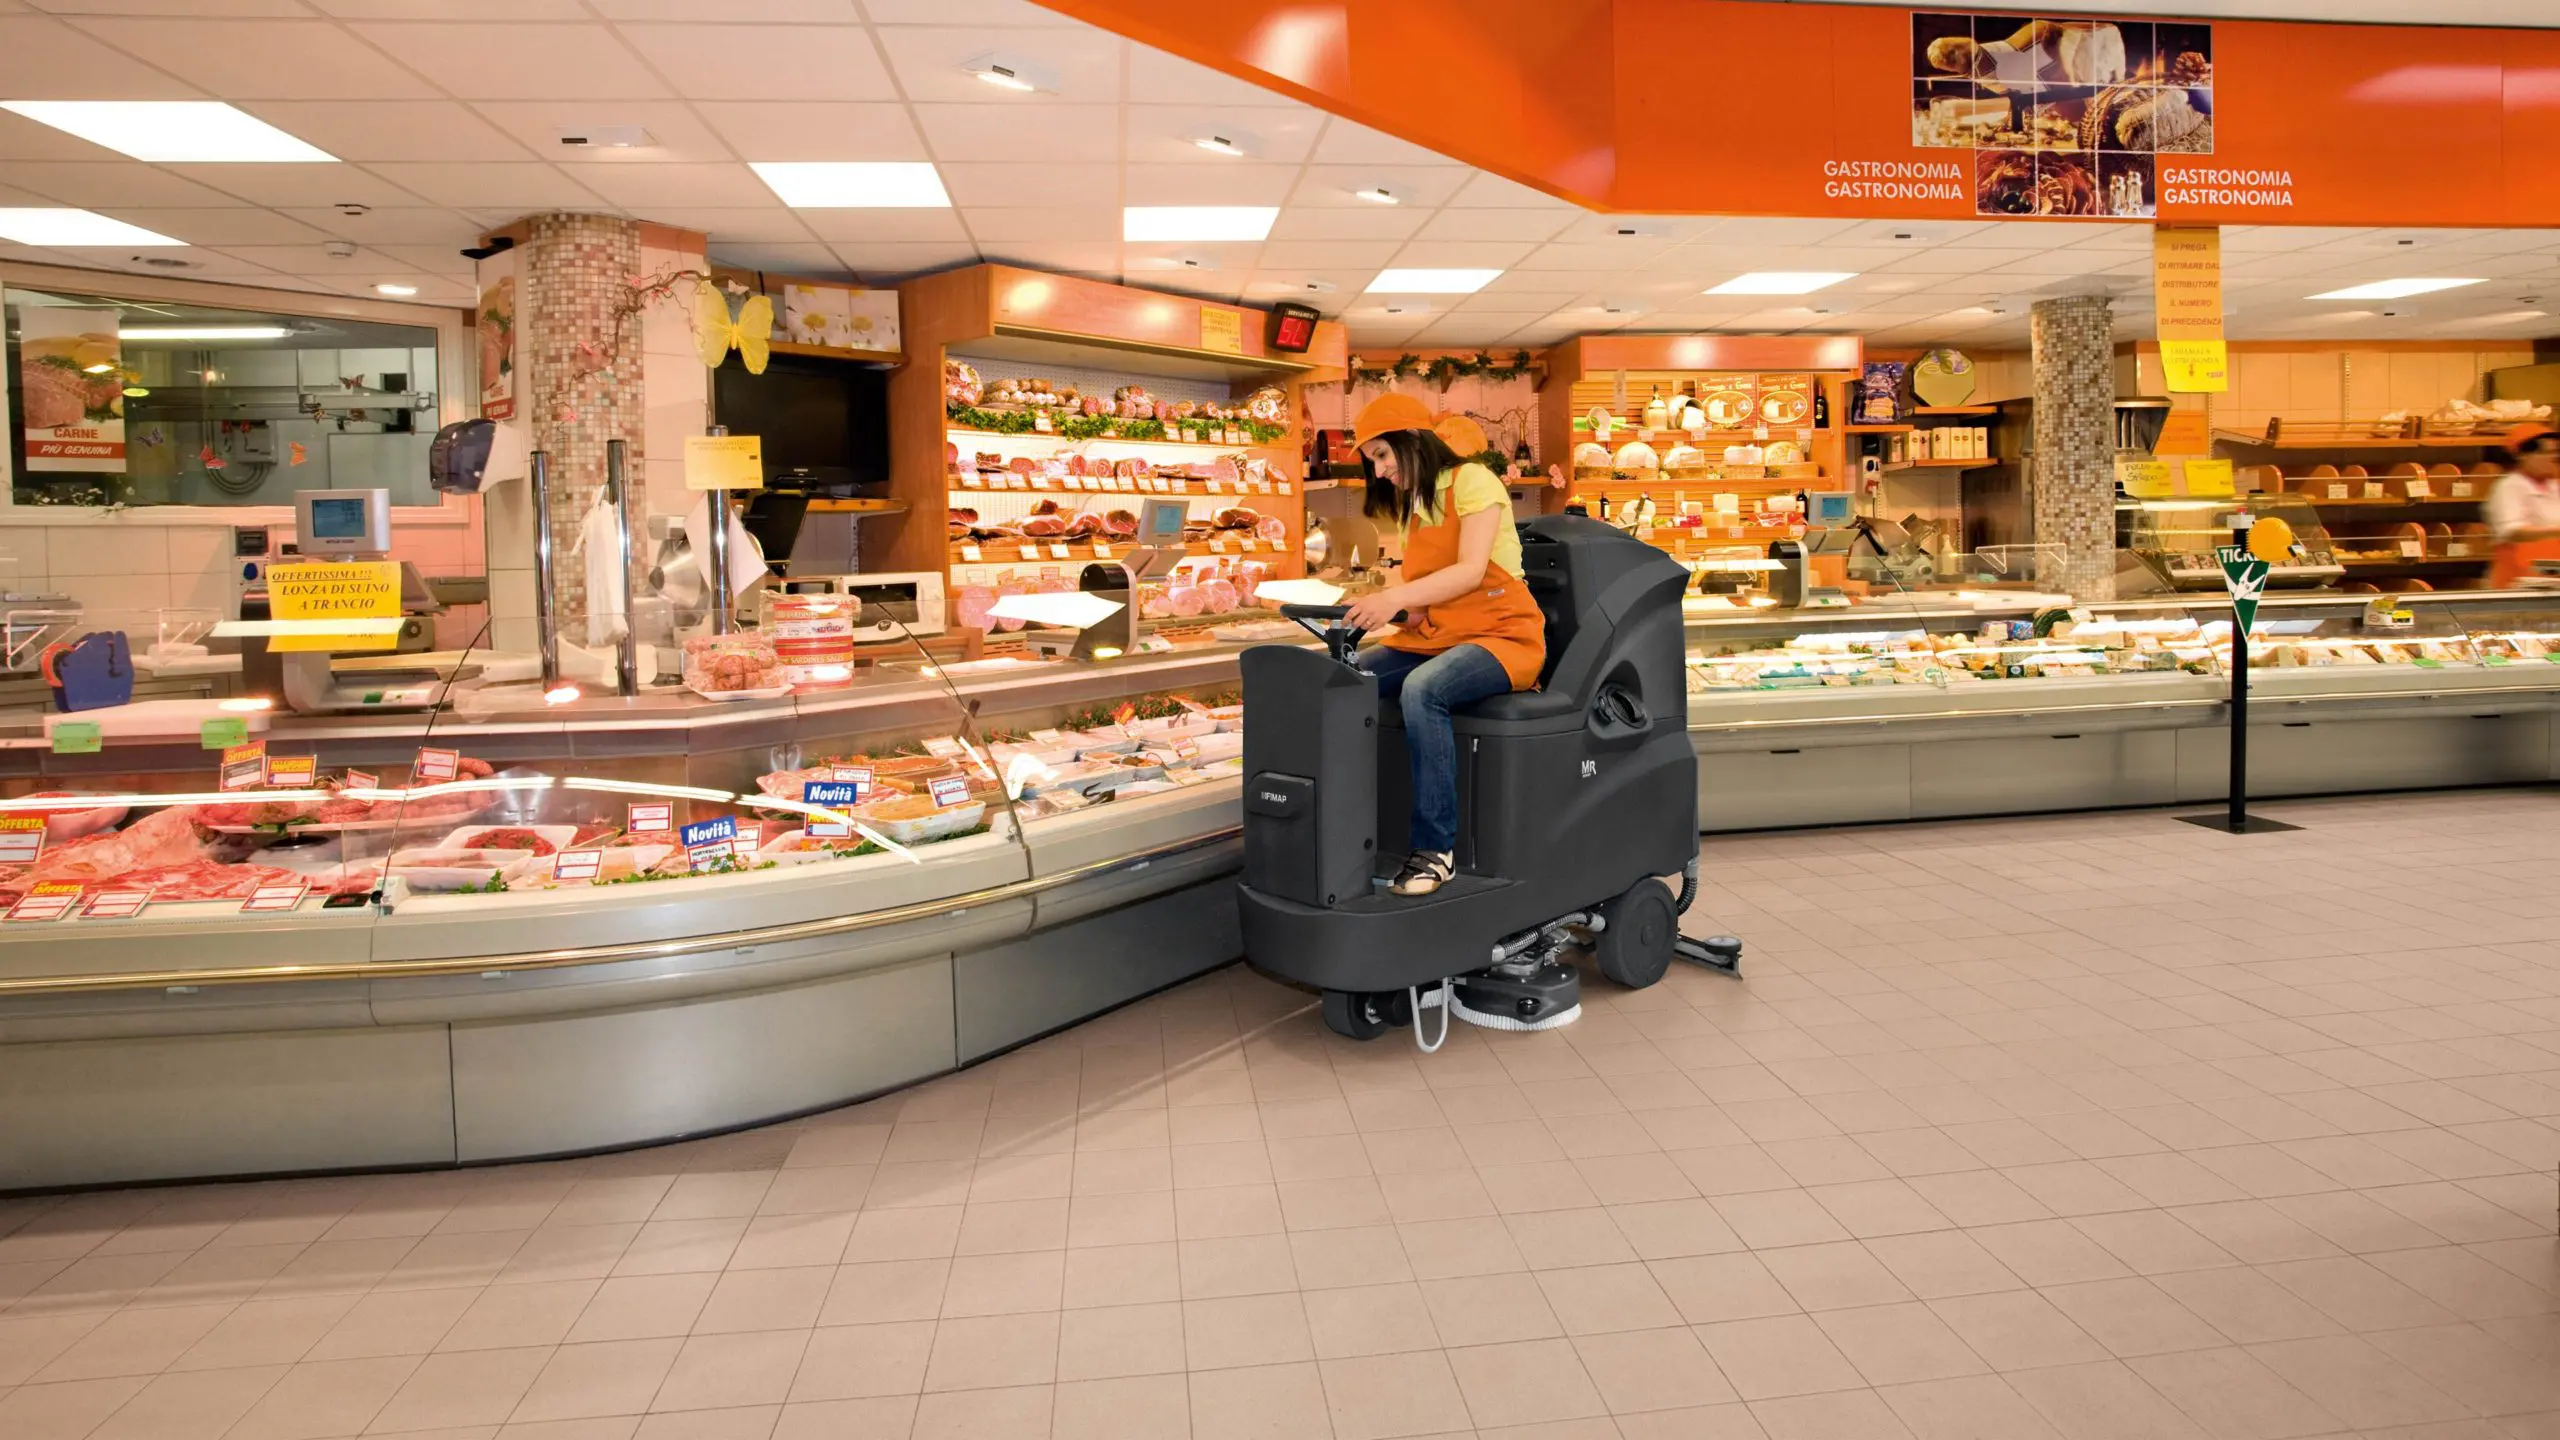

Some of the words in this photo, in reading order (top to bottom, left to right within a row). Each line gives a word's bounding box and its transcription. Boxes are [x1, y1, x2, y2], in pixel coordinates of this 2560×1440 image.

[1823, 160, 1962, 179] GASTRONOMIA
[2163, 168, 2293, 186] GASTRONOMIA
[1825, 181, 1964, 199] GASTRONOMIA
[2164, 188, 2293, 206] GASTRONOMIA
[2180, 243, 2207, 251] PREGA
[2168, 262, 2204, 270] RITIRARE
[2162, 280, 2218, 288] DISTRIBUTORE
[2178, 299, 2213, 307] NUMERO
[2171, 317, 2221, 326] PRECEDENZA
[54, 428, 98, 439] CARNE
[41, 444, 61, 454] PIÙ
[64, 445, 112, 455] GENUINA
[2220, 548, 2261, 564] TICK
[272, 570, 356, 581] OFFERTISSIMA
[282, 585, 326, 596] LONZA
[331, 585, 345, 594] DI
[348, 583, 390, 593] SUINO
[299, 601, 308, 610] A
[312, 599, 375, 610] TRANCIO
[226, 747, 262, 761] OFFERTA
[809, 784, 852, 801] Novità
[688, 821, 731, 844] Novità
